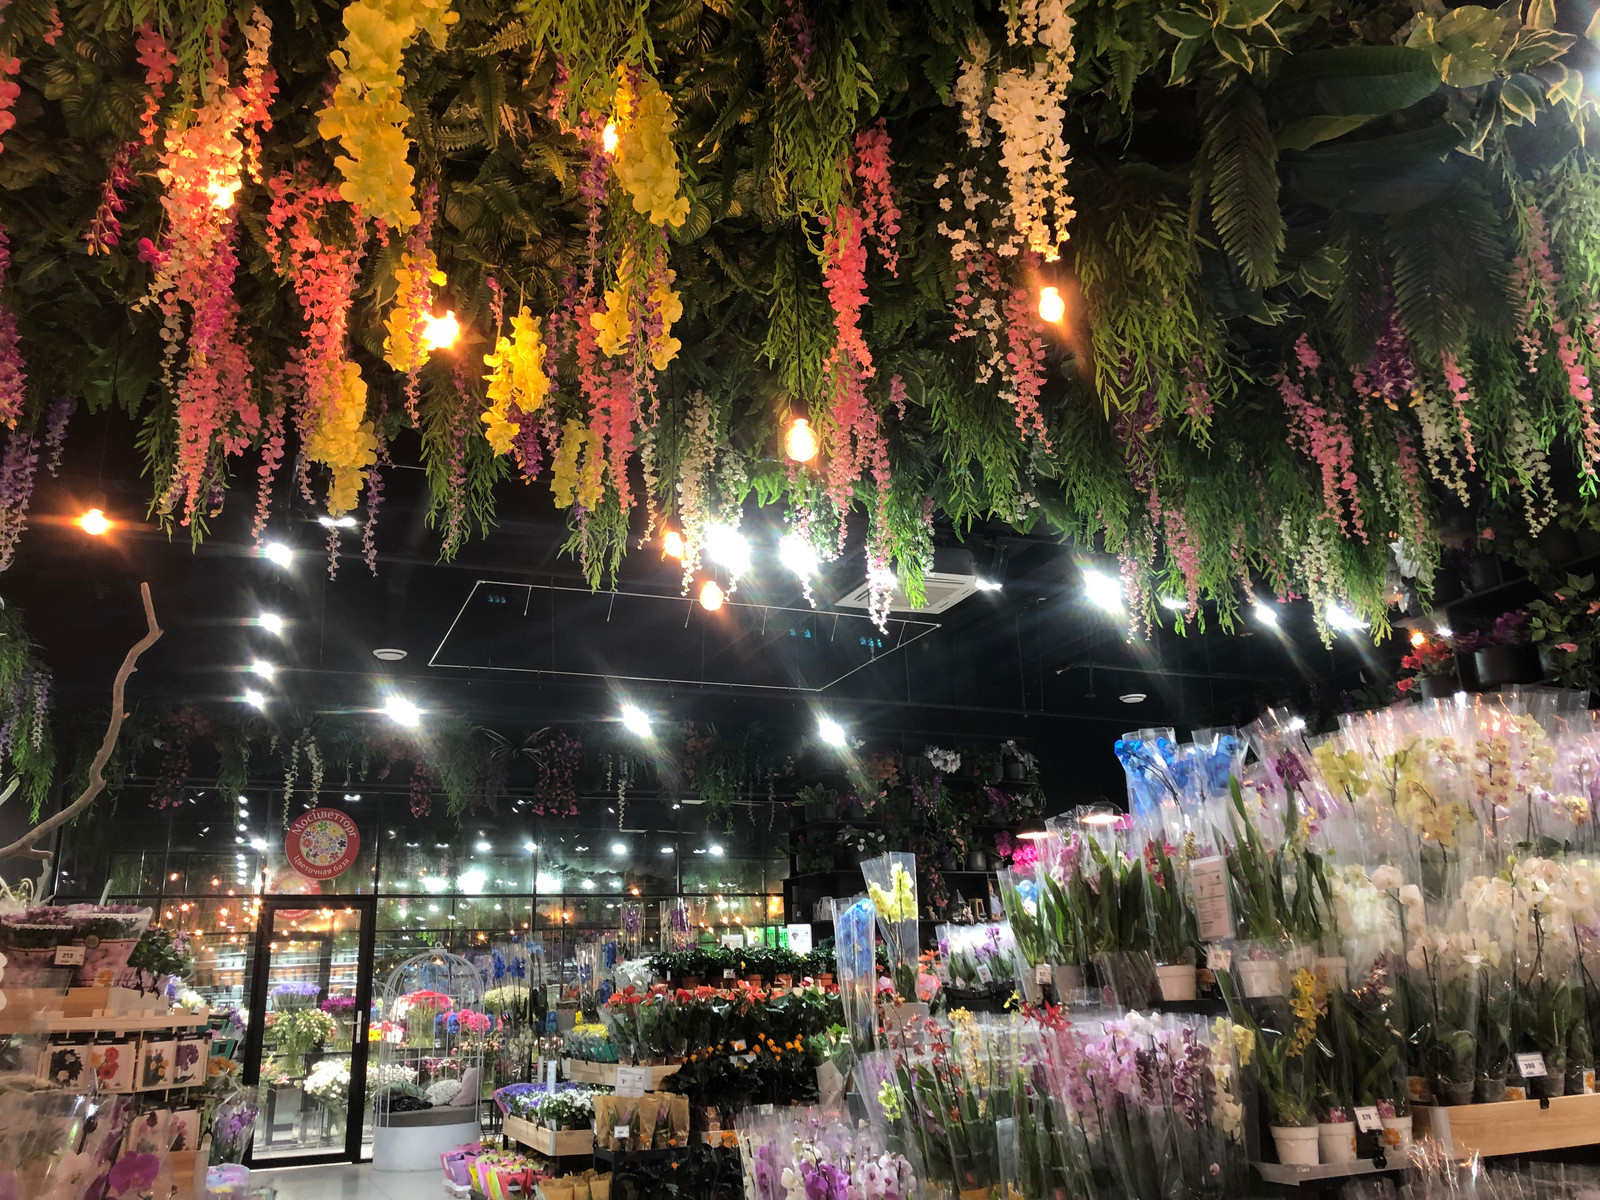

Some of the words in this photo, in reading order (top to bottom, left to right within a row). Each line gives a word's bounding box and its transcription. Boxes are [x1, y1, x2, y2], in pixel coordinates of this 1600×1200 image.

[291, 811, 357, 838] Мосцветторг
[293, 855, 332, 875] Цветочная
[333, 858, 350, 873] база
